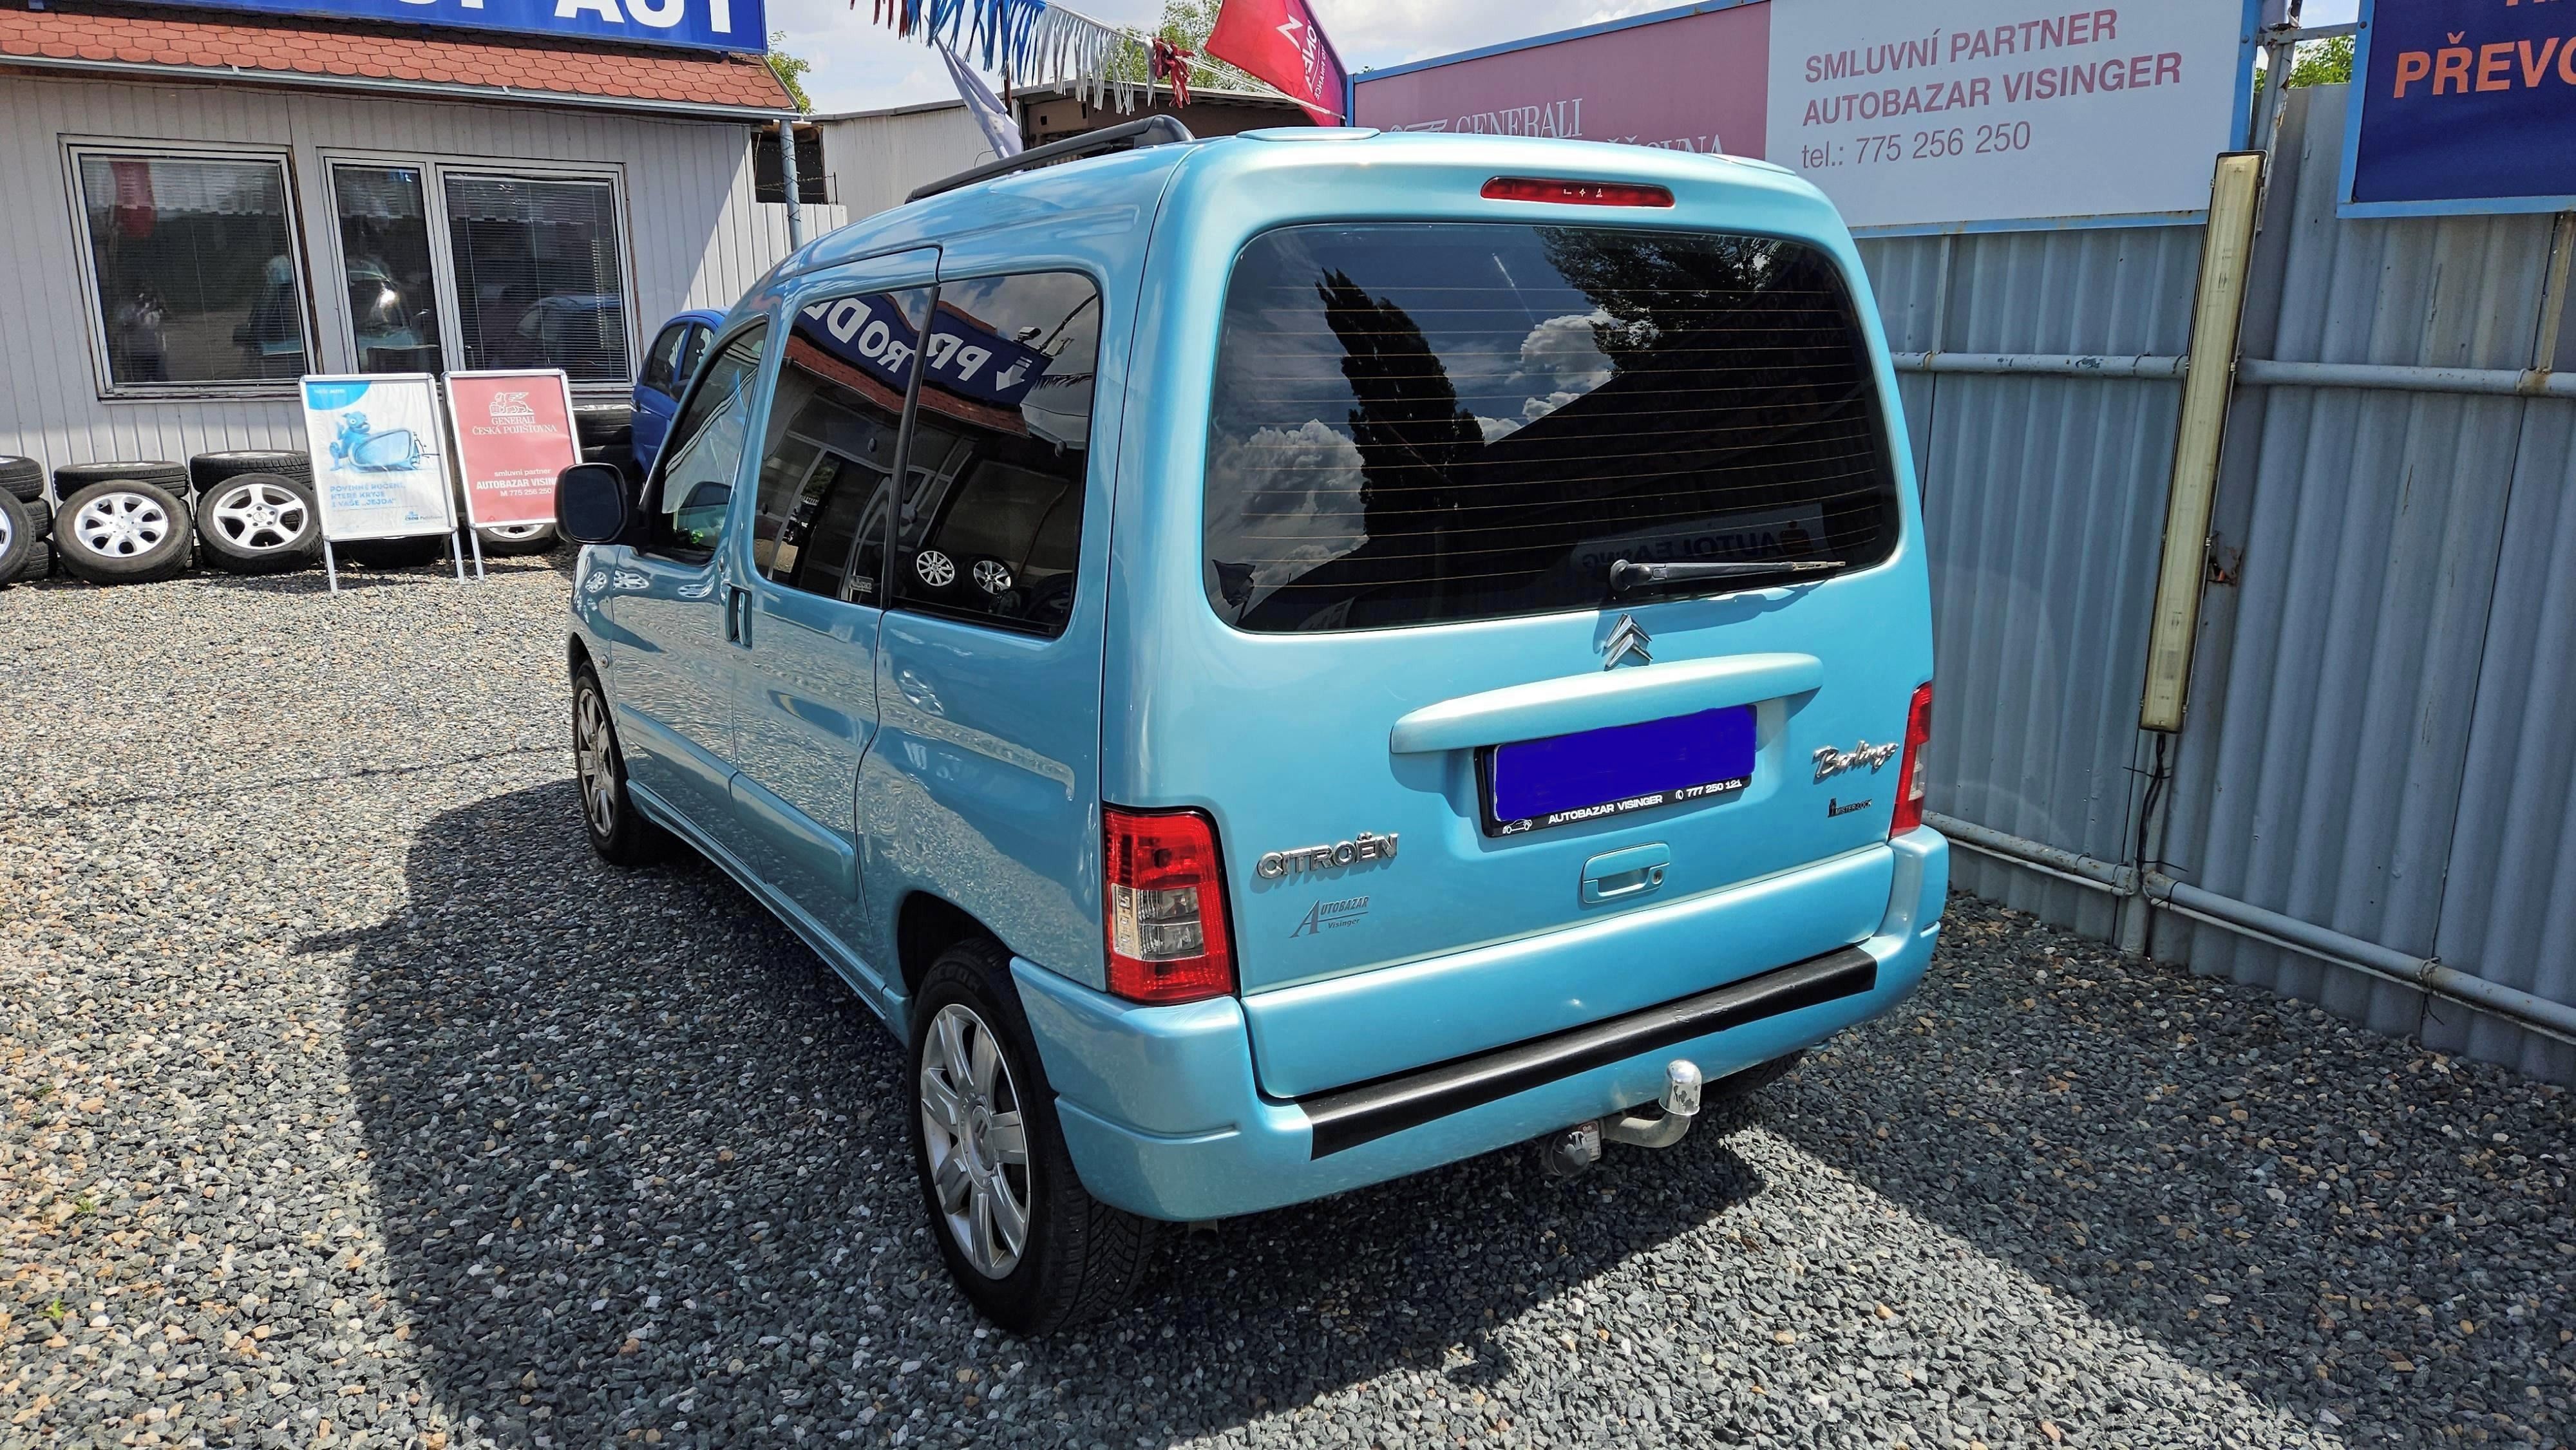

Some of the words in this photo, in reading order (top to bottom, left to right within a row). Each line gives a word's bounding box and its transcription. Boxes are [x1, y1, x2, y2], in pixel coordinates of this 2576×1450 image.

[1805, 30, 1941, 83] SMLUVNÍ
[1949, 8, 2118, 62] PARTNER
[1803, 77, 1991, 126] AUTOBAZAR
[2003, 52, 2183, 103] VISINGER
[1802, 142, 1844, 169] tel.:
[1856, 135, 1901, 165] 775
[1912, 128, 1964, 159] 256
[1975, 121, 2031, 153] 250
[472, 425, 503, 435] ČESKÁ
[504, 424, 557, 434] POJIŠŤOVNA
[491, 416, 535, 425] GENERALI
[477, 478, 529, 489] AUTOBAZAR
[1813, 740, 1899, 778] Berlingo
[1548, 804, 1615, 824] AUTOBAZAR
[1617, 795, 1663, 811] VISINGER
[1686, 786, 1703, 798] 777
[1705, 782, 1723, 794] 250
[1726, 779, 1742, 790] 121
[1257, 832, 1399, 879] CITROËN
[1289, 896, 1369, 938] AUTOBAZAR
[1328, 918, 1361, 929] Visinger
